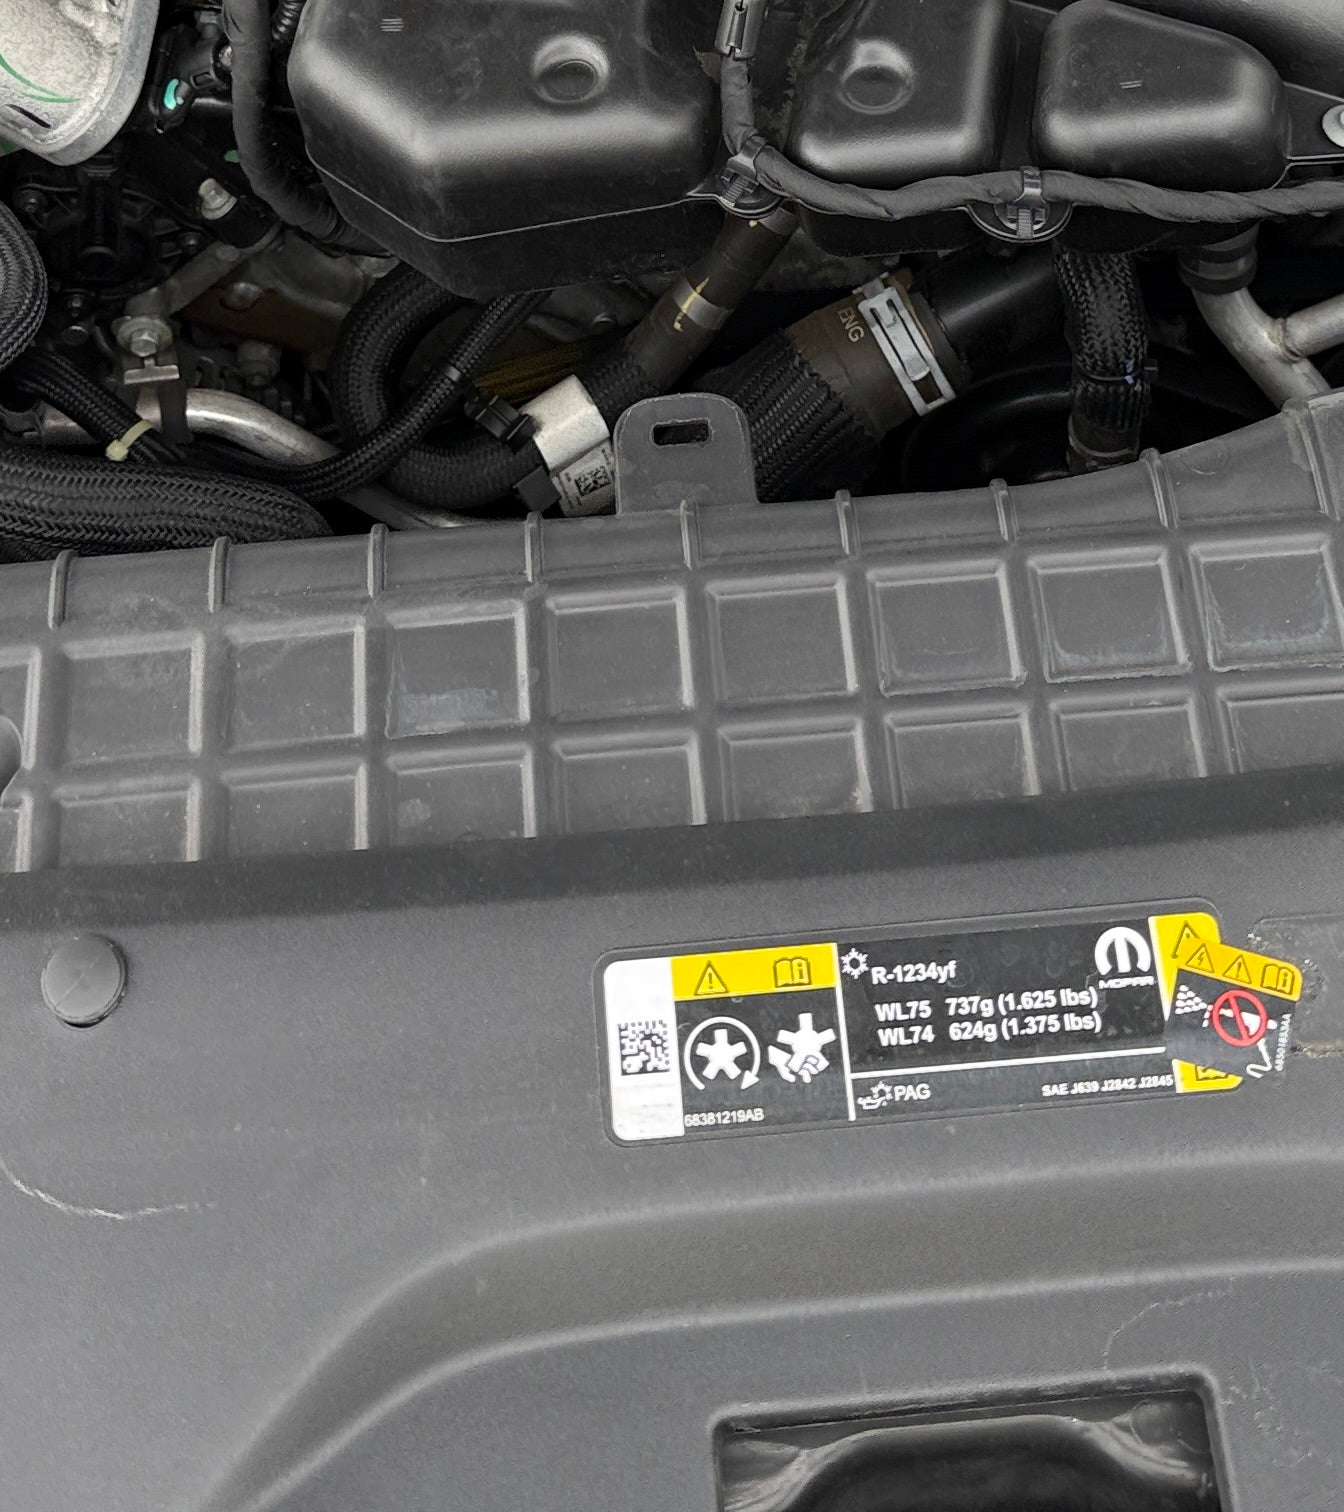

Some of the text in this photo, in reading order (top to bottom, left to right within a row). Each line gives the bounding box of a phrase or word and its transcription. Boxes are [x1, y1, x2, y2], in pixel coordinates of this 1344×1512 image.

[837, 306, 865, 343] ENG
[871, 960, 957, 984] R-1234yf
[1098, 975, 1155, 989] MOPAR
[874, 986, 1098, 1022] WL75 737g (1.625 lbs)
[877, 1010, 1102, 1046] WL74 624g (1.375 lbs)
[893, 1083, 932, 1101] PAG
[1042, 1074, 1173, 1097] SAE J639 J2842 J2845
[684, 1108, 765, 1128] 68381219AB
